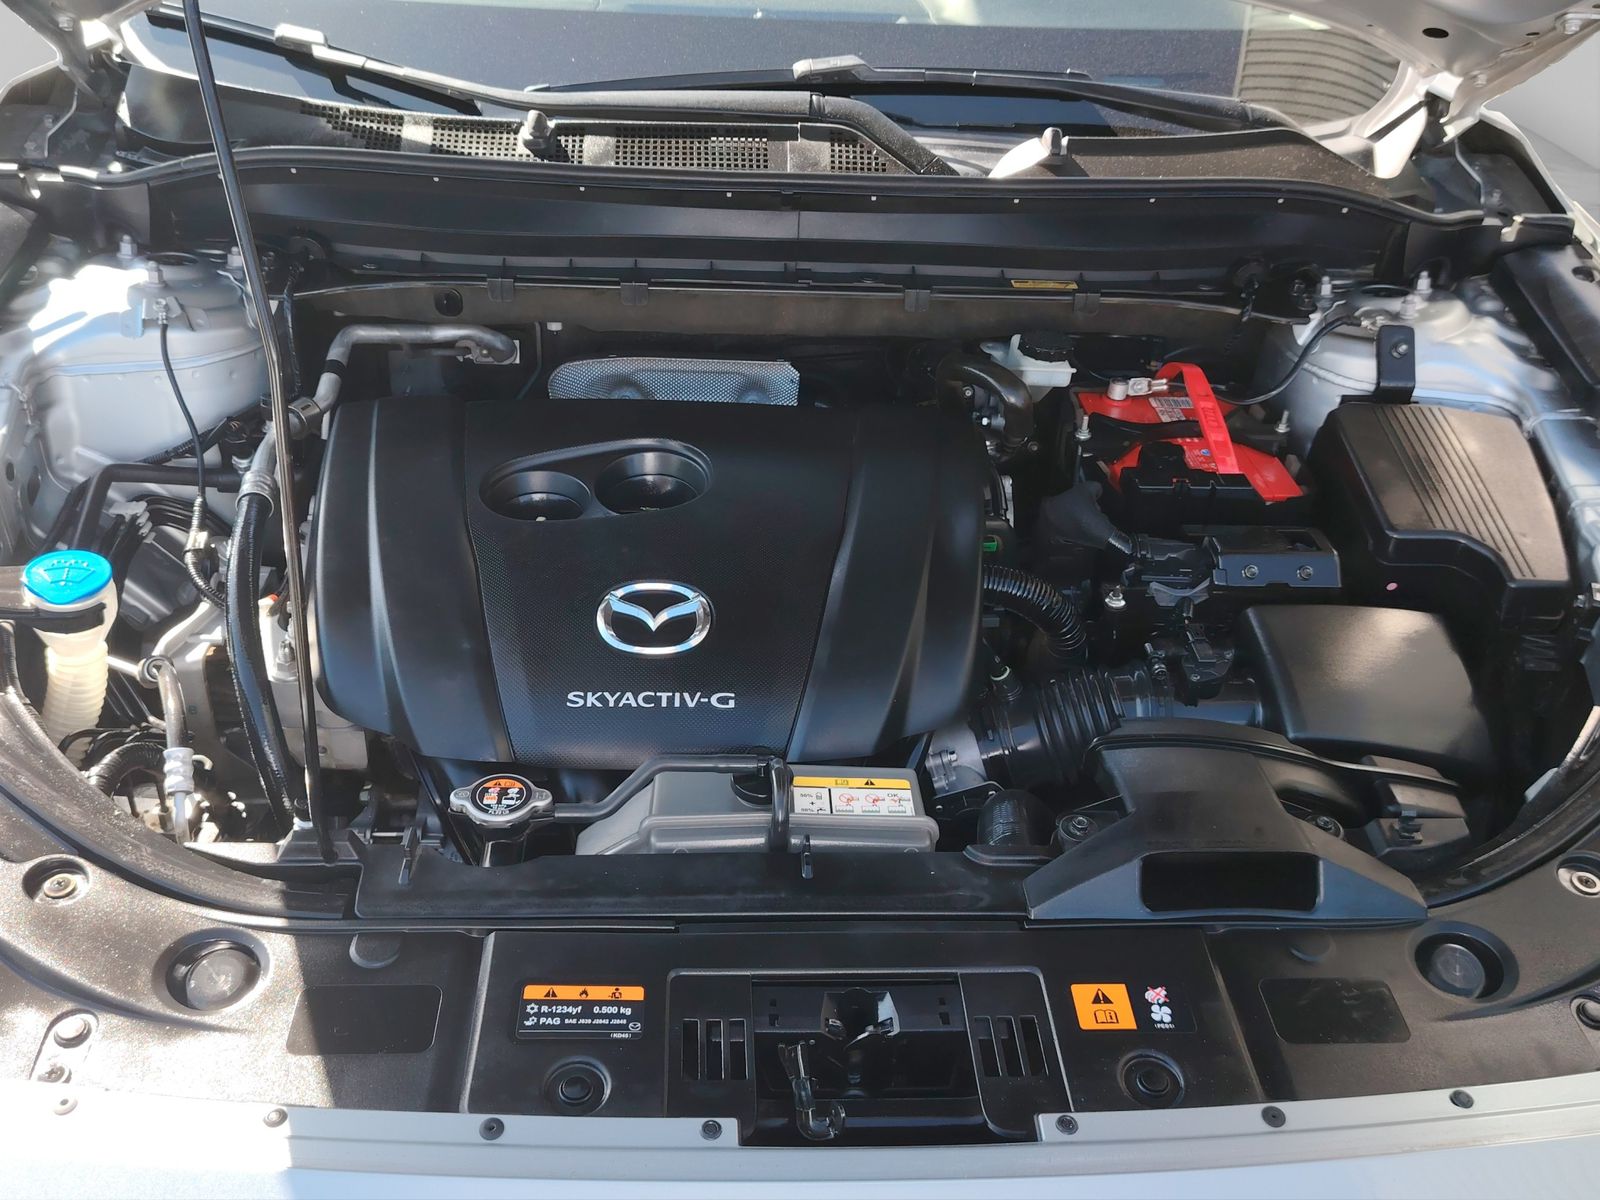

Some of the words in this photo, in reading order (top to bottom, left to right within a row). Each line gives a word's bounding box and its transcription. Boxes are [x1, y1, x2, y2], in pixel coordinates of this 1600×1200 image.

[566, 691, 735, 708] SKYACTIV-G
[540, 1005, 582, 1015] R-1234yf
[593, 1005, 618, 1014] 0.500
[619, 1006, 632, 1015] kg
[539, 1017, 561, 1025] PAG
